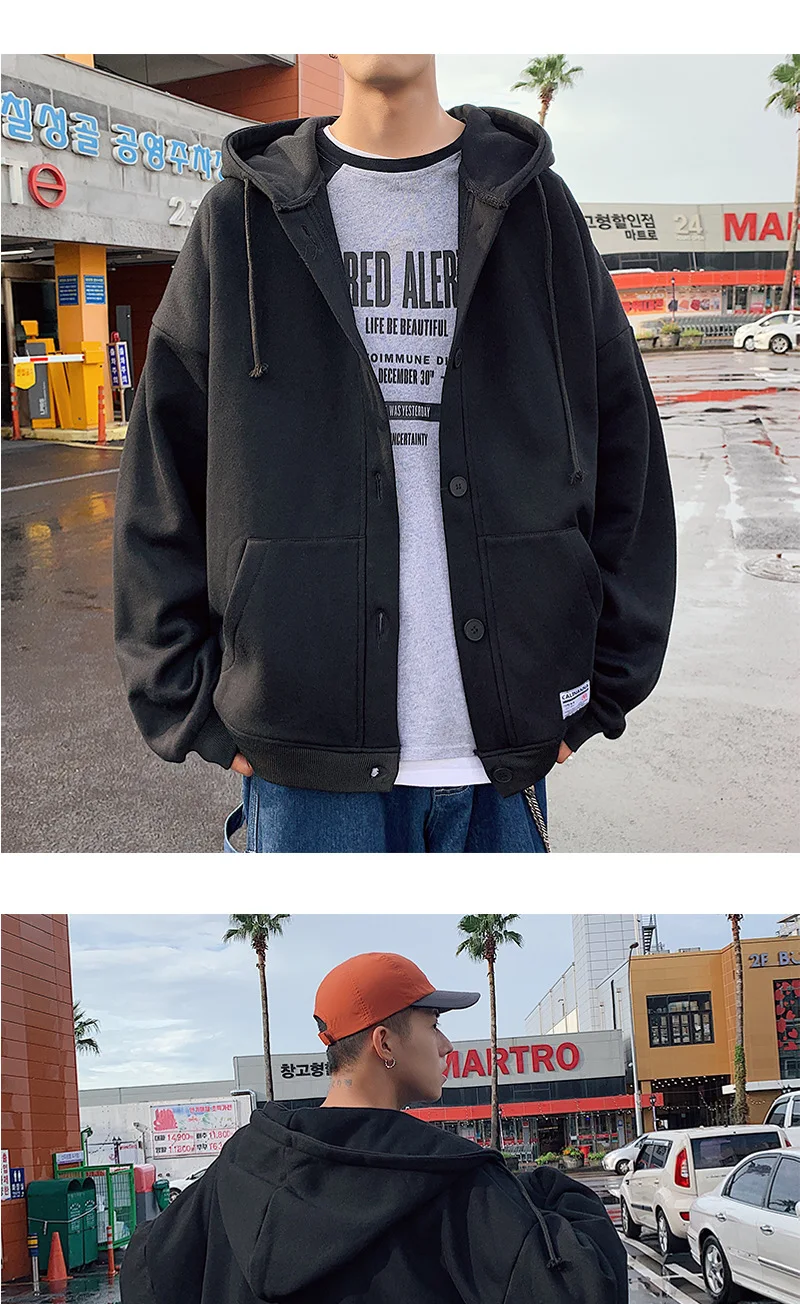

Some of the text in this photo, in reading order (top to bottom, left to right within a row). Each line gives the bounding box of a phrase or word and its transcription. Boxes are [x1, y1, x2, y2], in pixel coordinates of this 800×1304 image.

[625, 229, 658, 241] 마트로
[402, 250, 458, 308] ALER
[365, 317, 449, 337] LIFE BE BEAUTIFUL
[367, 353, 431, 365] OIMMUNE
[379, 367, 418, 384] DECEMBER
[402, 405, 431, 418] YESTERDAY
[391, 432, 429, 446] NCERTAINTY
[749, 952, 769, 968] 2F
